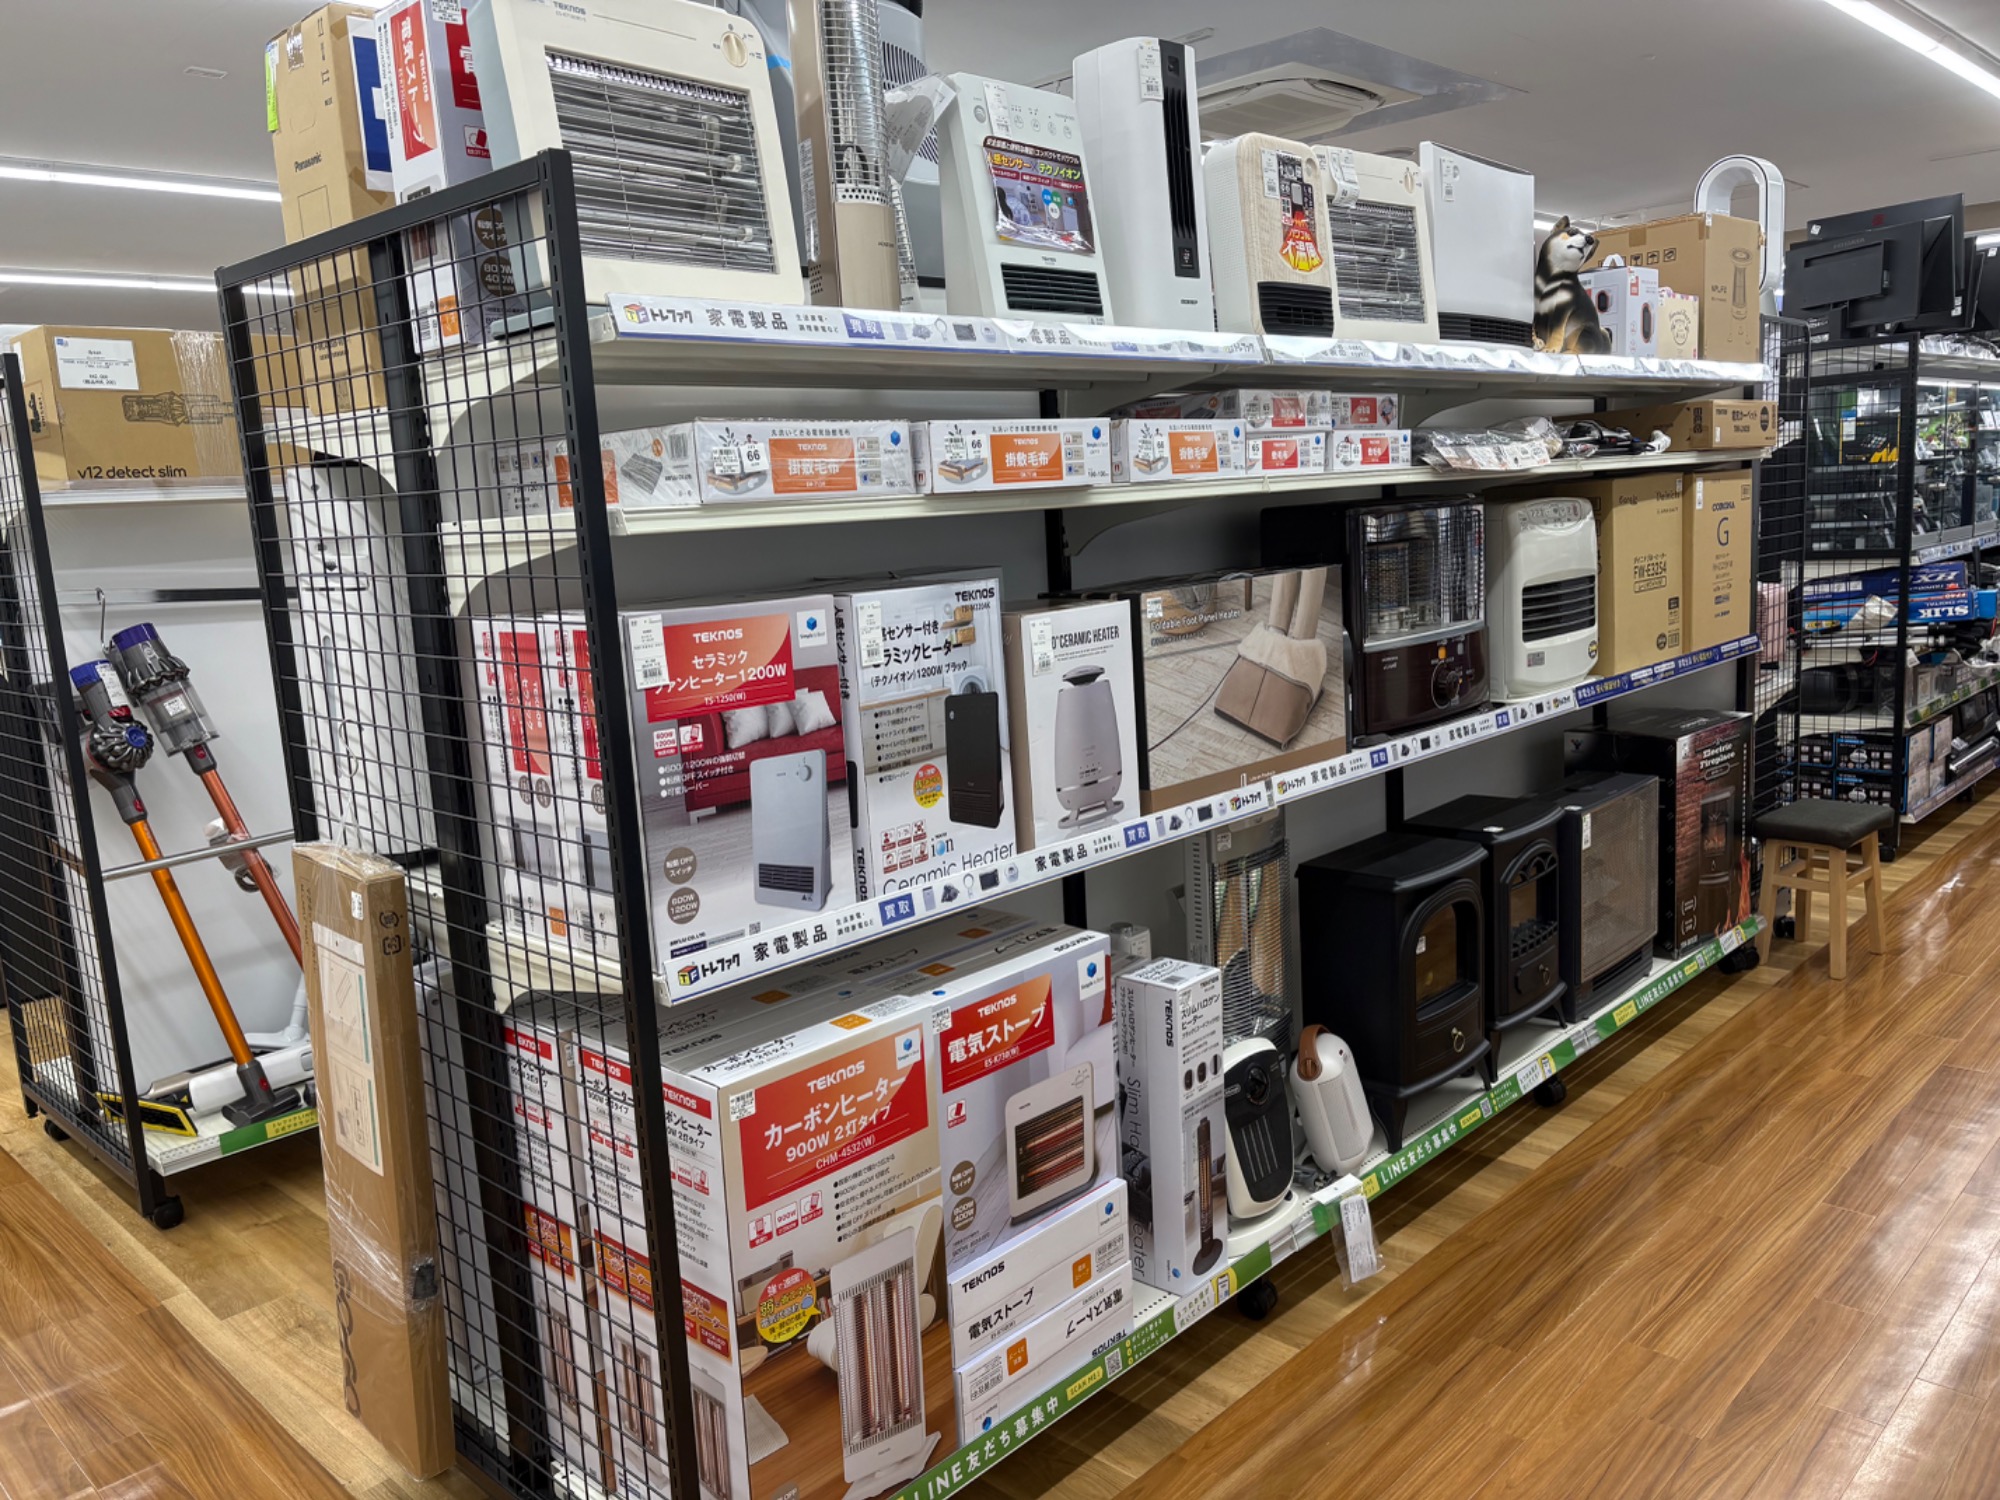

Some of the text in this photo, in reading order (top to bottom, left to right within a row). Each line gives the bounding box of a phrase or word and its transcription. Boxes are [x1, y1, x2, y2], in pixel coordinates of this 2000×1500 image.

[400, 15, 426, 145] 電気ストーブ
[417, 50, 430, 103] TEKNOS
[294, 152, 323, 173] Panasonic
[1039, 163, 1081, 180] テクノイオン
[705, 307, 789, 331] 家電製品
[849, 317, 881, 336] 買取
[746, 449, 761, 462] 66
[971, 438, 983, 450] 66
[1178, 446, 1209, 462] 掛敷毛布
[1252, 443, 1260, 452] 65
[787, 458, 841, 477] 掛敷毛布
[1004, 451, 1049, 469] 掛敷毛布
[77, 464, 188, 481] v12 detect slim
[1716, 516, 1730, 547] G
[954, 586, 996, 603] TEKNOS
[1182, 612, 1199, 626] Foot
[1198, 610, 1218, 623] Panel
[1218, 607, 1241, 620] Heater
[1917, 605, 1970, 620] SLIK
[692, 627, 744, 645] TEKNOS
[1059, 625, 1120, 649] CERAMIC HEATER
[691, 648, 749, 671] セラミック
[834, 605, 850, 701] 人感センサー付き
[872, 638, 963, 668] ラミックヒーター
[944, 660, 968, 674] ブラック
[703, 691, 747, 707] TS-1250(W)
[1699, 751, 1736, 770] Fireplace
[1703, 742, 1733, 759] Electric
[1310, 764, 1348, 786] 家電製品
[1239, 790, 1262, 808] トレファク
[1125, 825, 1149, 845] 買取
[961, 842, 1015, 871] Heater
[1033, 844, 1089, 873] 家電製品
[669, 864, 693, 878] スイッチ
[882, 862, 958, 897] Ceramic
[669, 901, 699, 915] 1200W
[883, 898, 912, 923] 買取
[701, 952, 741, 978] トレファク
[752, 923, 829, 963] 家電製品
[976, 993, 1018, 1019] TEKNOS
[1181, 992, 1222, 1020] スリムハロゲン
[946, 1001, 1048, 1066] 電気ストーブ
[1126, 987, 1138, 1068] スリムハロゲンヒーター
[1164, 998, 1175, 1048] TEKNOS
[1181, 1013, 1204, 1031] ヒーター
[701, 1034, 798, 1074] カーボンヒーター
[591, 1056, 622, 1078] TEKNOS
[806, 1059, 866, 1094] TEKNOS
[1126, 1076, 1142, 1115] Slim
[664, 1110, 713, 1138] ボンヒーター
[763, 1076, 907, 1151] カーボンヒーター
[785, 1101, 893, 1163] 900W 2灯タイプ
[815, 1134, 876, 1171] CHM-4532(W)
[1379, 1122, 1458, 1185] LINE友だち募集中
[953, 1176, 972, 1190] スイッチ
[777, 1210, 797, 1223] 900W
[961, 1260, 1006, 1294] TEKNOS
[968, 1286, 1035, 1342] 電気ストーブ
[1065, 1287, 1125, 1340] 電気ストーブ
[1090, 1328, 1128, 1358] TEKNOS
[1069, 1377, 1087, 1396] SCAN
